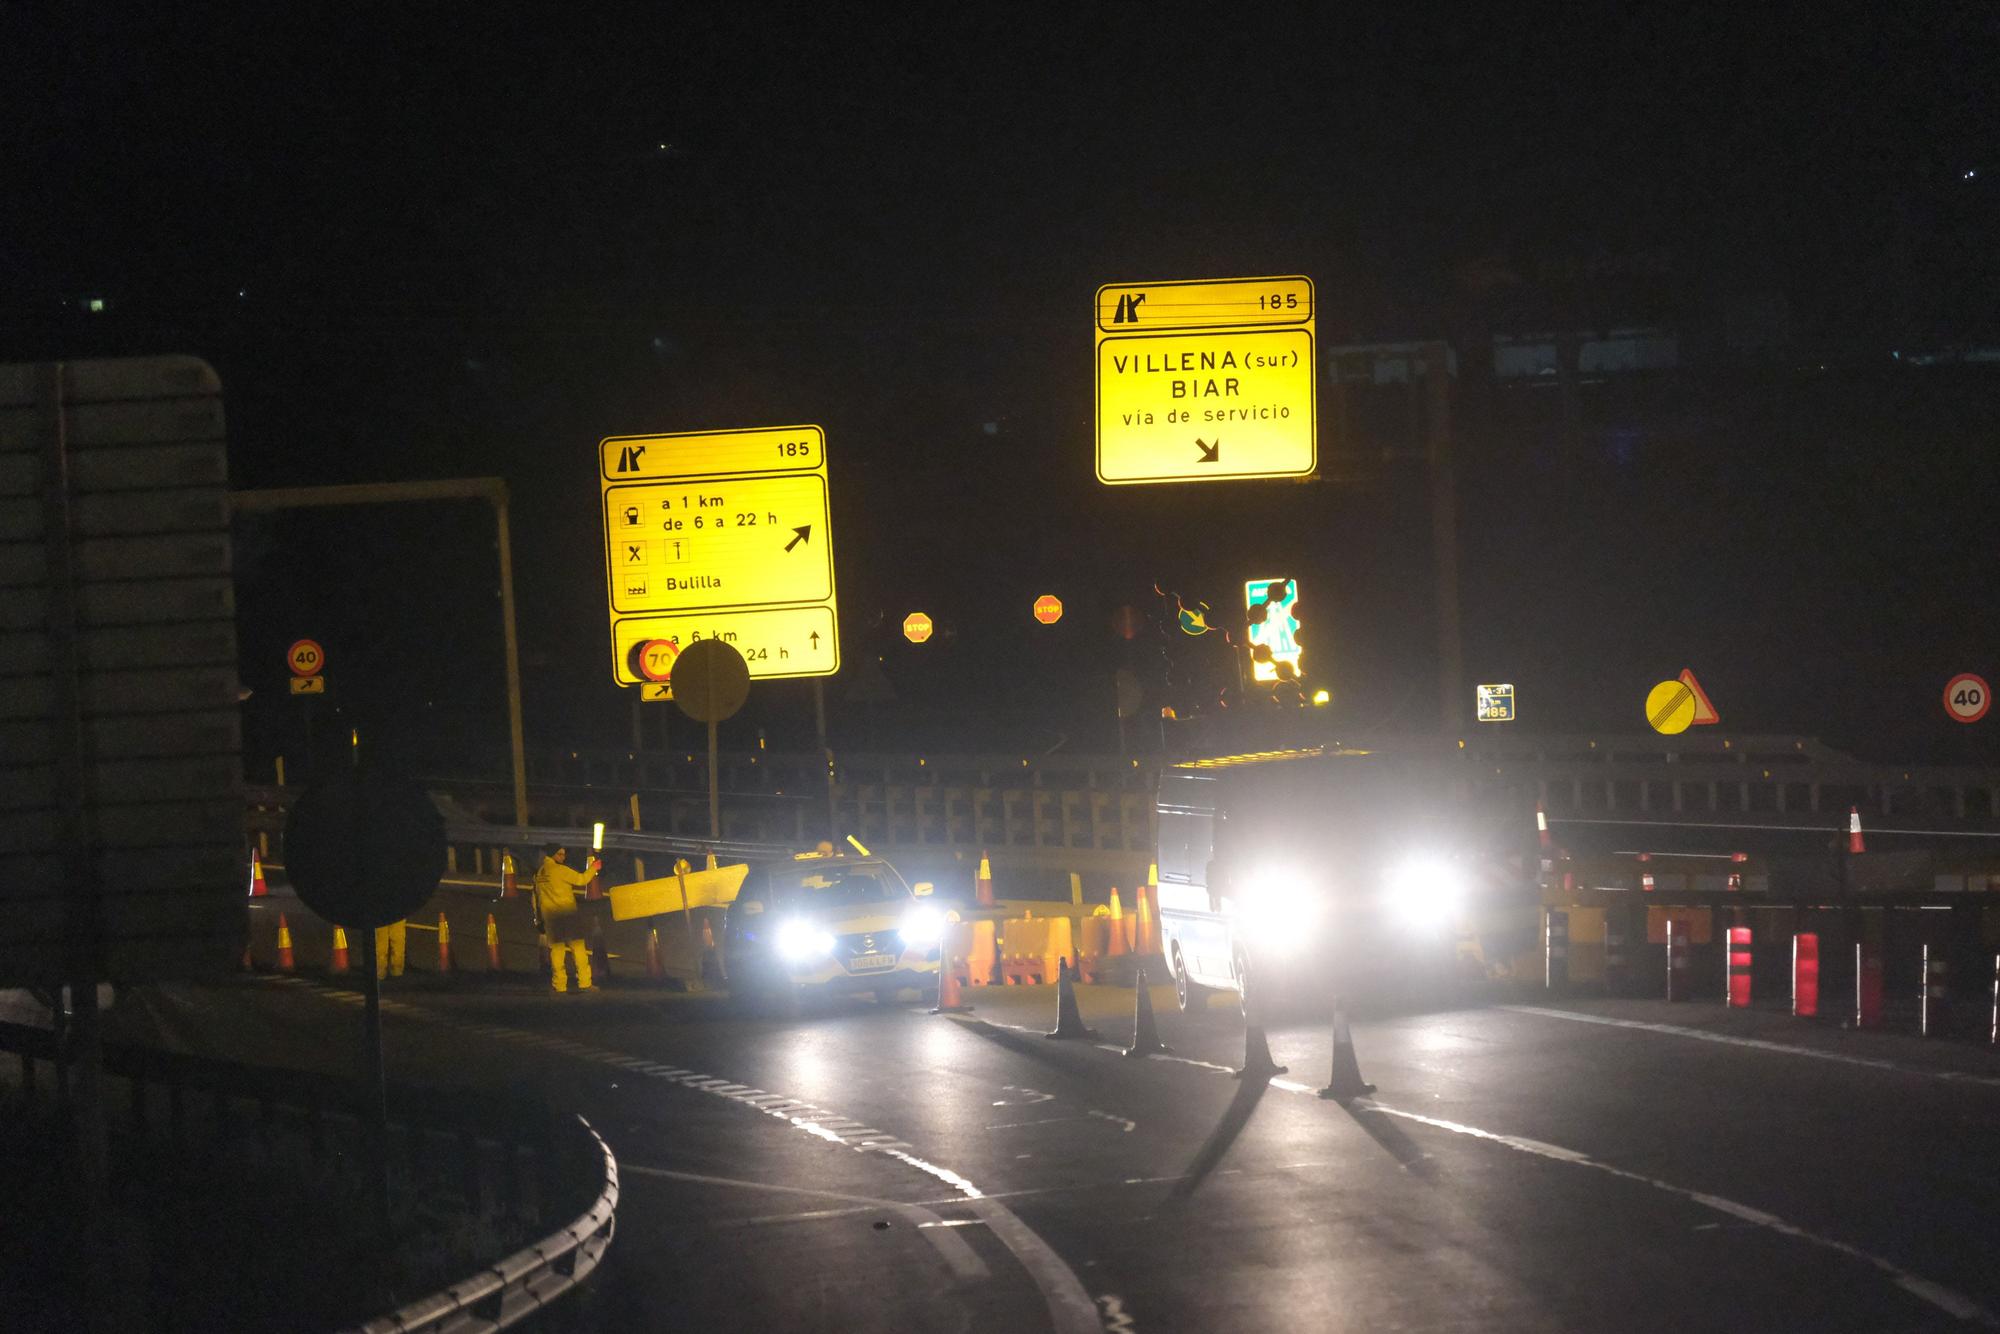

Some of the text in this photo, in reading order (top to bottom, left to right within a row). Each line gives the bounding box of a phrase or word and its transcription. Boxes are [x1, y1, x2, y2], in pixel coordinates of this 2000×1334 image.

[1259, 294, 1298, 310] 185
[1114, 350, 1298, 374] VILLENA (sur)
[1172, 378, 1240, 399] BIAR
[1122, 404, 1290, 426] vía de servicio
[778, 442, 810, 458] 185
[661, 495, 724, 510] a 1 km
[663, 512, 777, 531] de 6 a 22 h
[667, 576, 721, 591] Bulilla
[1036, 604, 1060, 613] STOP
[906, 623, 930, 632] STOP
[671, 630, 738, 645] a 6 km
[295, 652, 316, 663] 40
[649, 653, 672, 667] 70
[747, 647, 789, 661] 24 h
[1953, 690, 1980, 705] 40
[1487, 707, 1507, 717] 185
